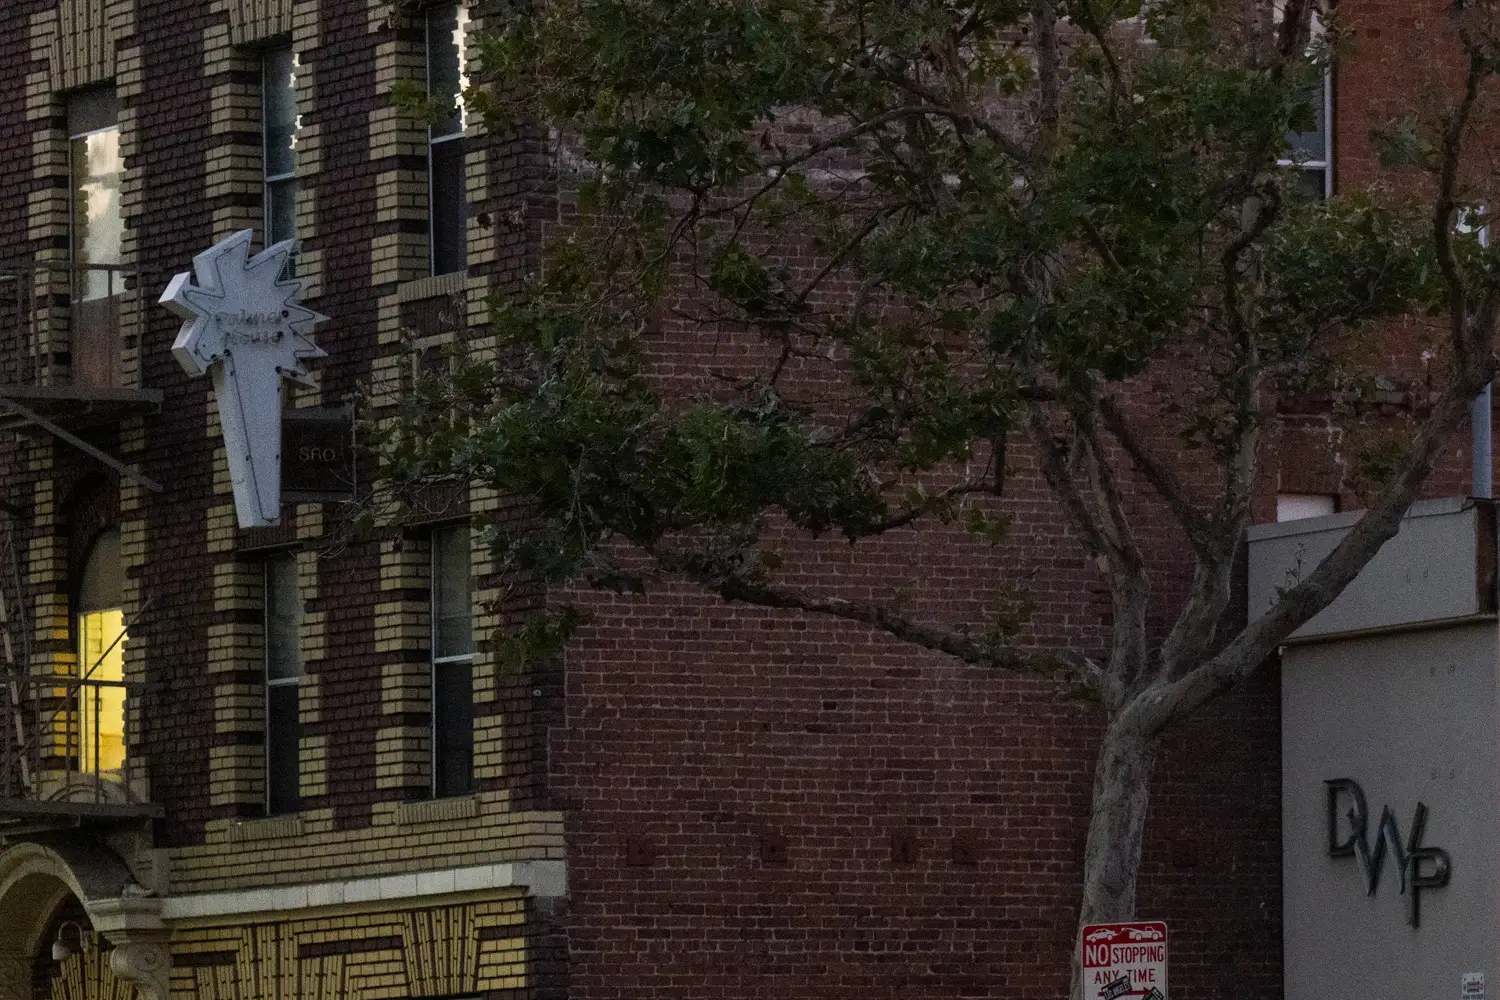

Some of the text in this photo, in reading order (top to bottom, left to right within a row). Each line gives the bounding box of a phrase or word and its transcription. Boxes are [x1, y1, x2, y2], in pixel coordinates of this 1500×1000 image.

[1323, 777, 1451, 929] DWP
[1085, 943, 1163, 966] NO STOPPING
[1095, 969, 1155, 984] ANY TIME
